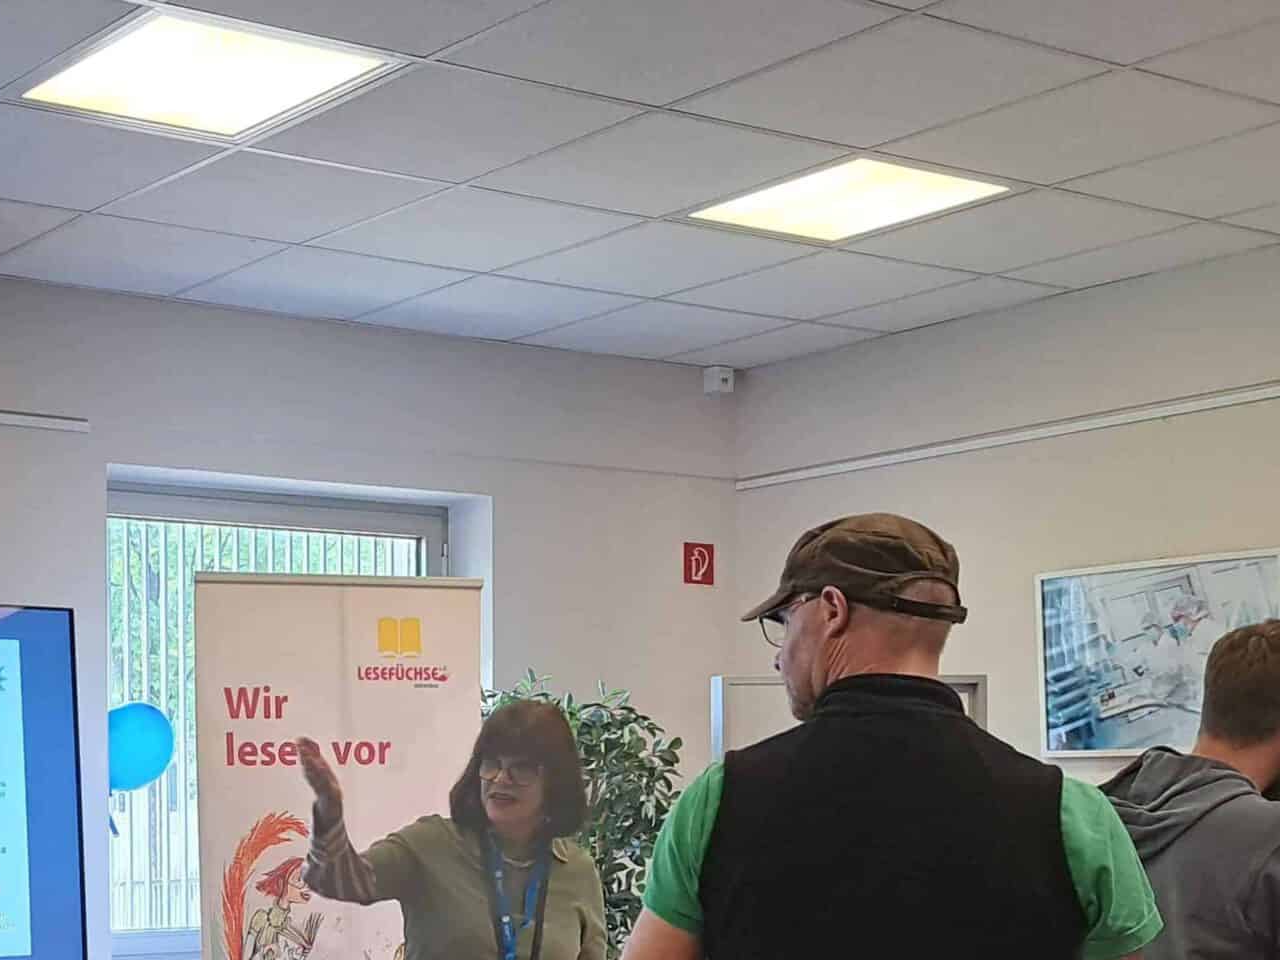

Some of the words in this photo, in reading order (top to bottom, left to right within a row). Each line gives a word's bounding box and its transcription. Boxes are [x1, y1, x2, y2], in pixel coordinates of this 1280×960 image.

[357, 663, 439, 681] LESEFÜCHSE
[223, 685, 289, 720] Wir
[225, 731, 300, 767] lese
[331, 740, 392, 766] vor
